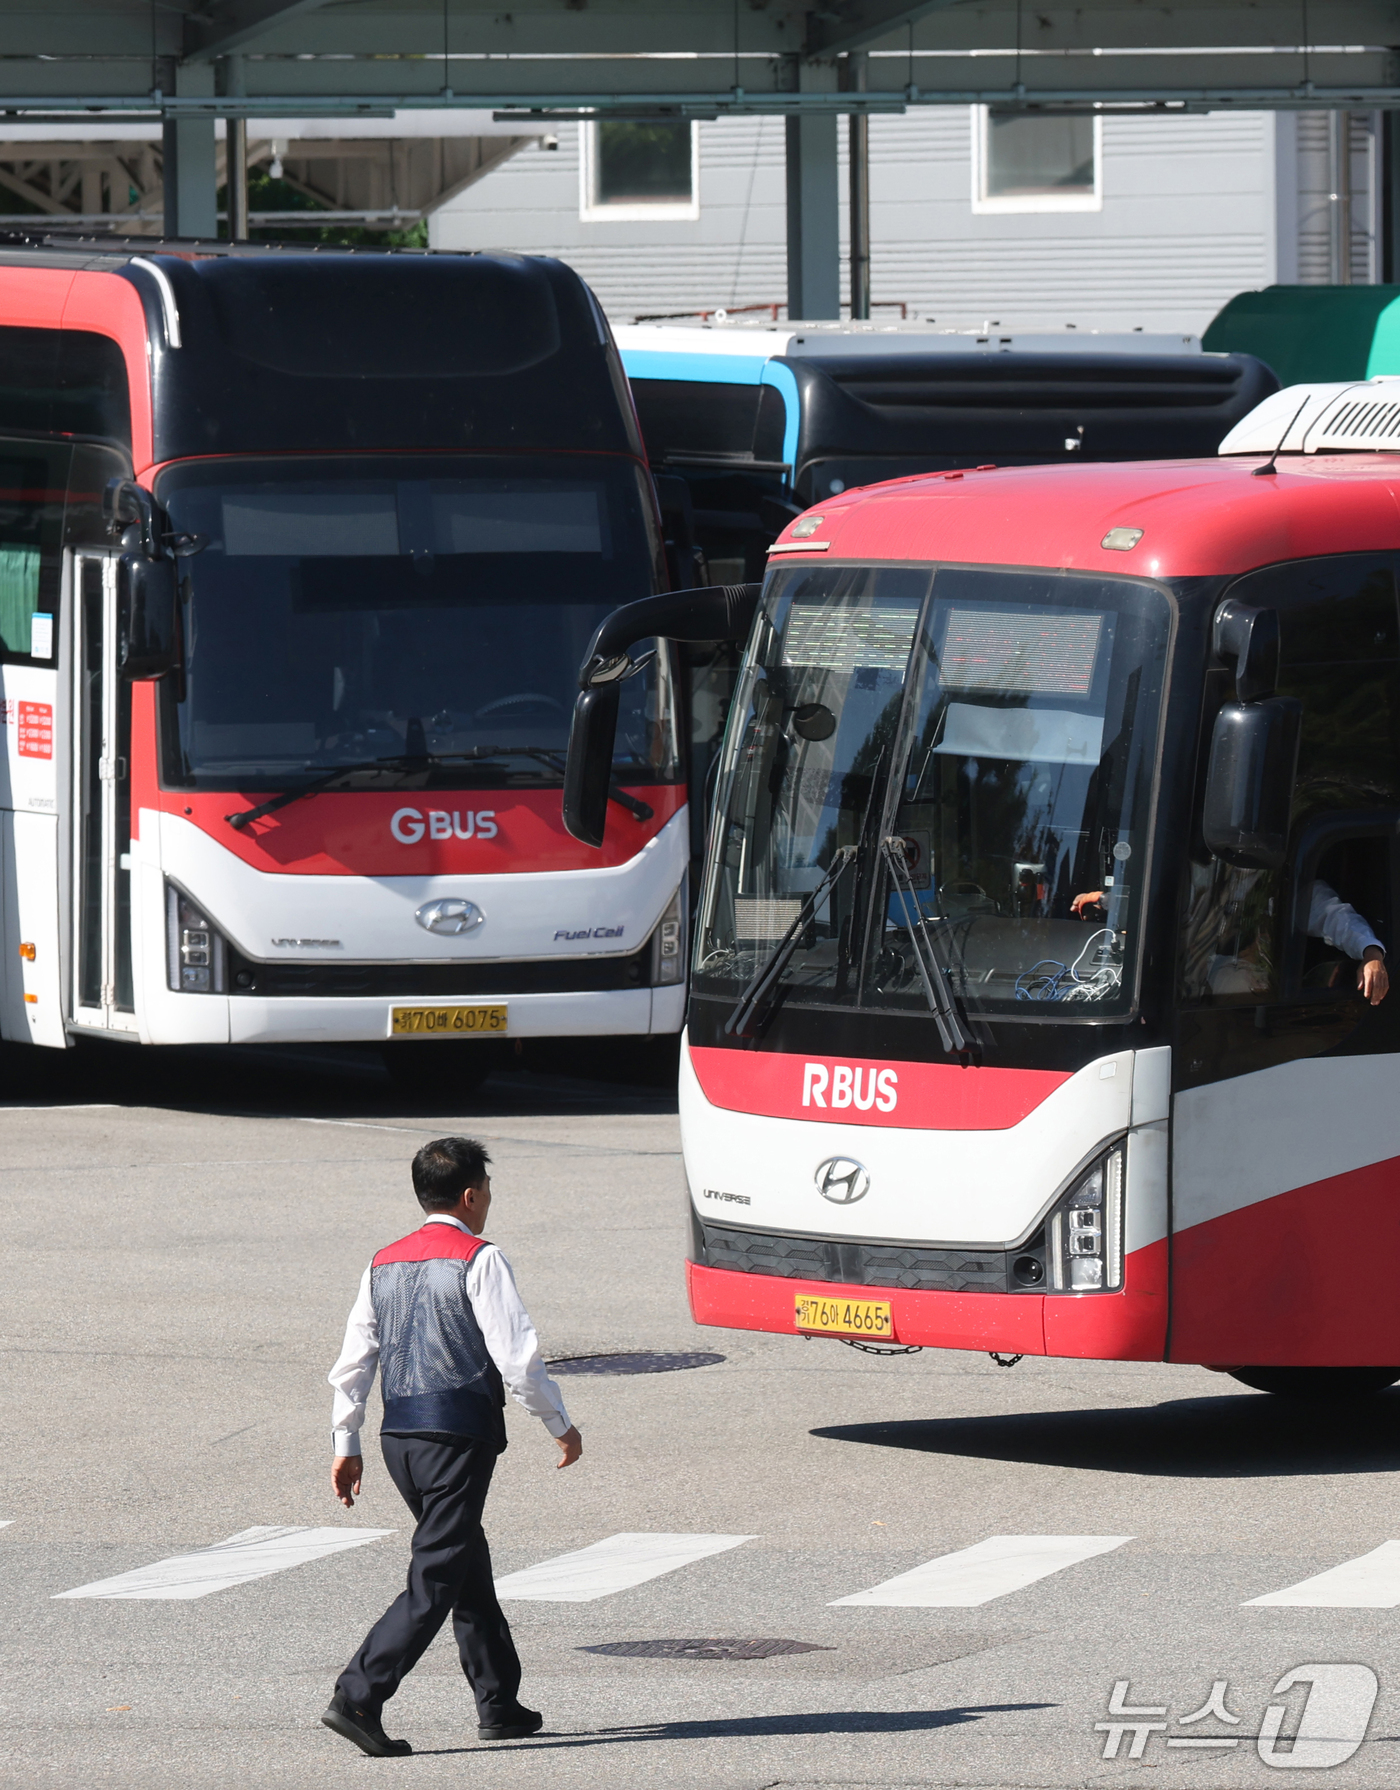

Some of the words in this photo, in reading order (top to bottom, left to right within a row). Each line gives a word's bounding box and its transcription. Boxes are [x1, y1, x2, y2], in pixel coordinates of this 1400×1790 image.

[553, 927, 592, 941] Fuel
[592, 925, 625, 939] Cell
[451, 1009, 500, 1029] 6075
[703, 1188, 751, 1206] UNIVERSE
[843, 1304, 884, 1331] 4665
